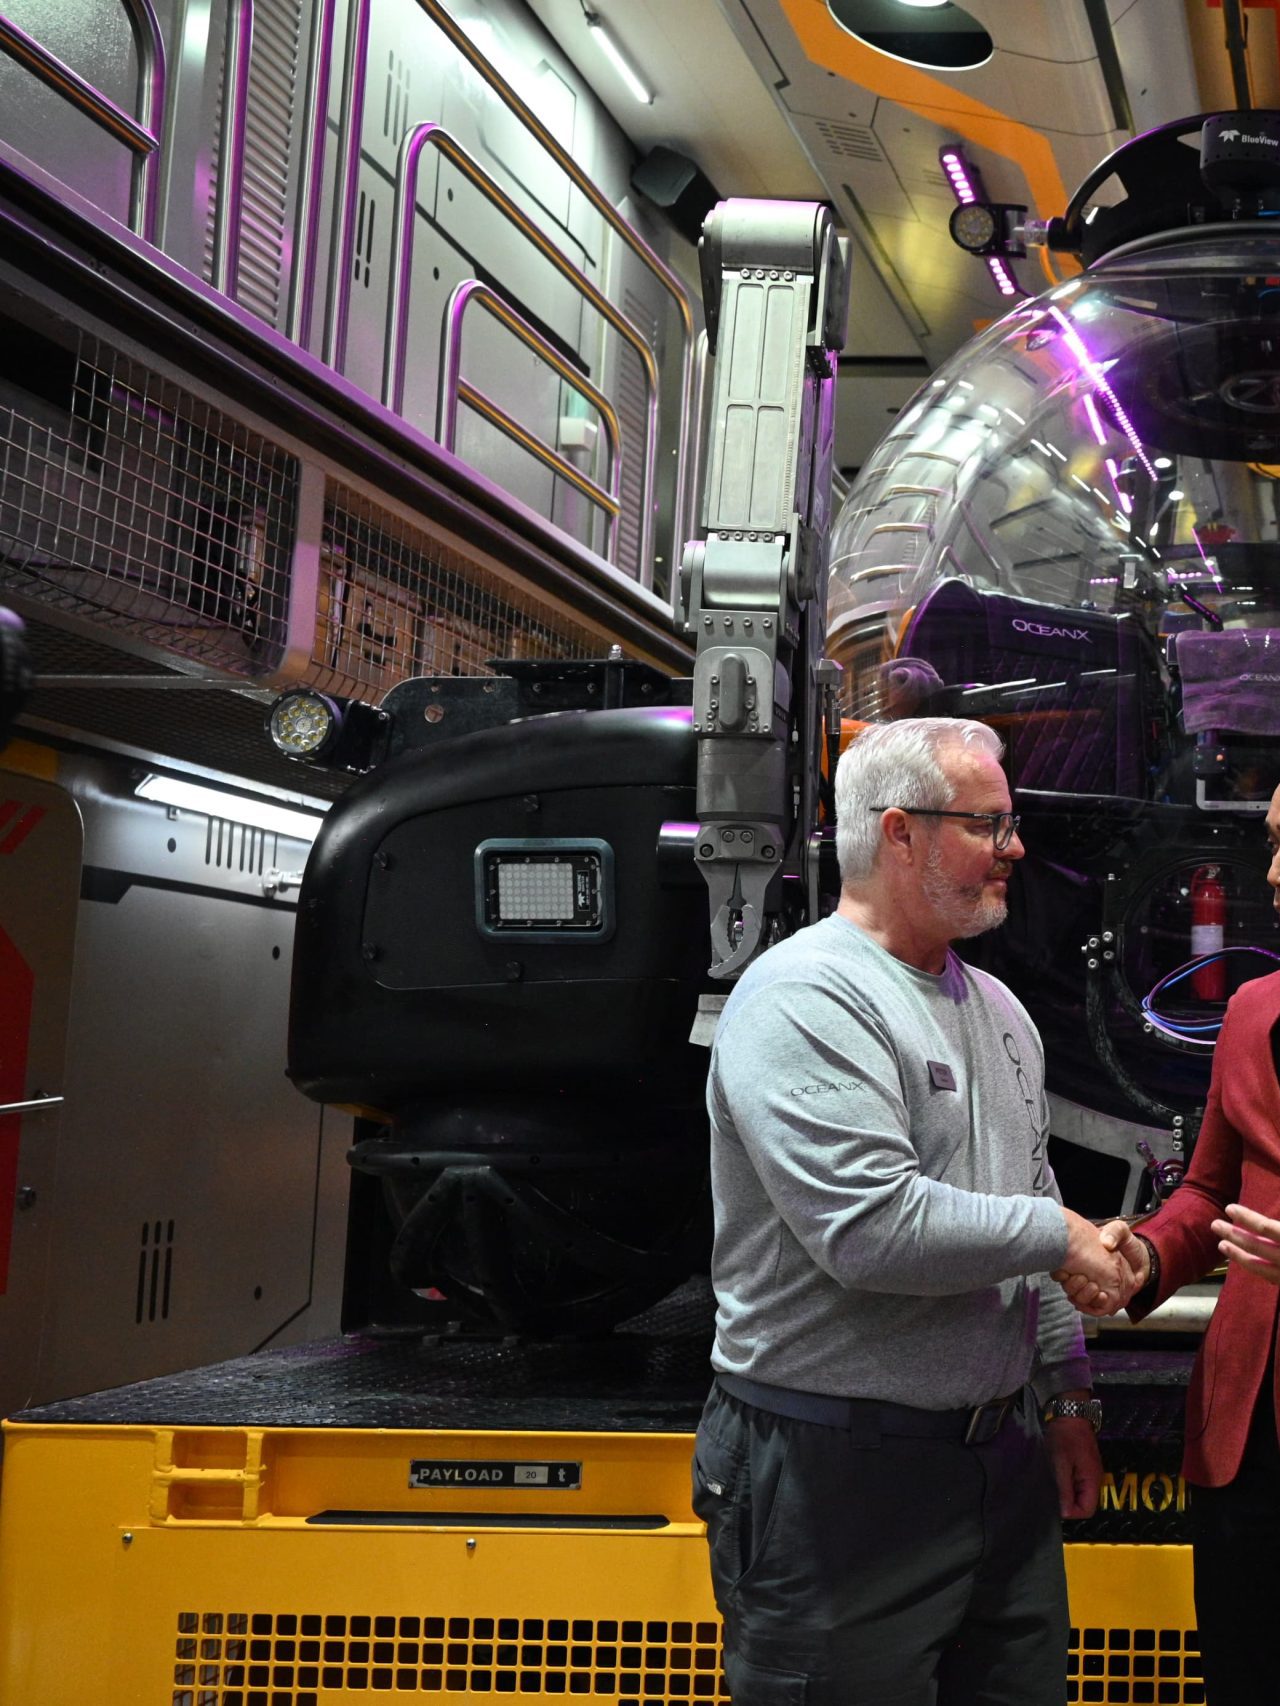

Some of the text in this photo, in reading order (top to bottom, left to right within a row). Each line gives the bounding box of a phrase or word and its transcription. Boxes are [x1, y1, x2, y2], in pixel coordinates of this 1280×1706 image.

[1241, 134, 1279, 147] BlueView
[1011, 619, 1093, 644] OCEANX
[790, 1081, 866, 1097] OCEANX
[1003, 1032, 1044, 1197] OCEAN
[419, 1468, 504, 1481] PAYLOAD
[525, 1471, 537, 1479] 20
